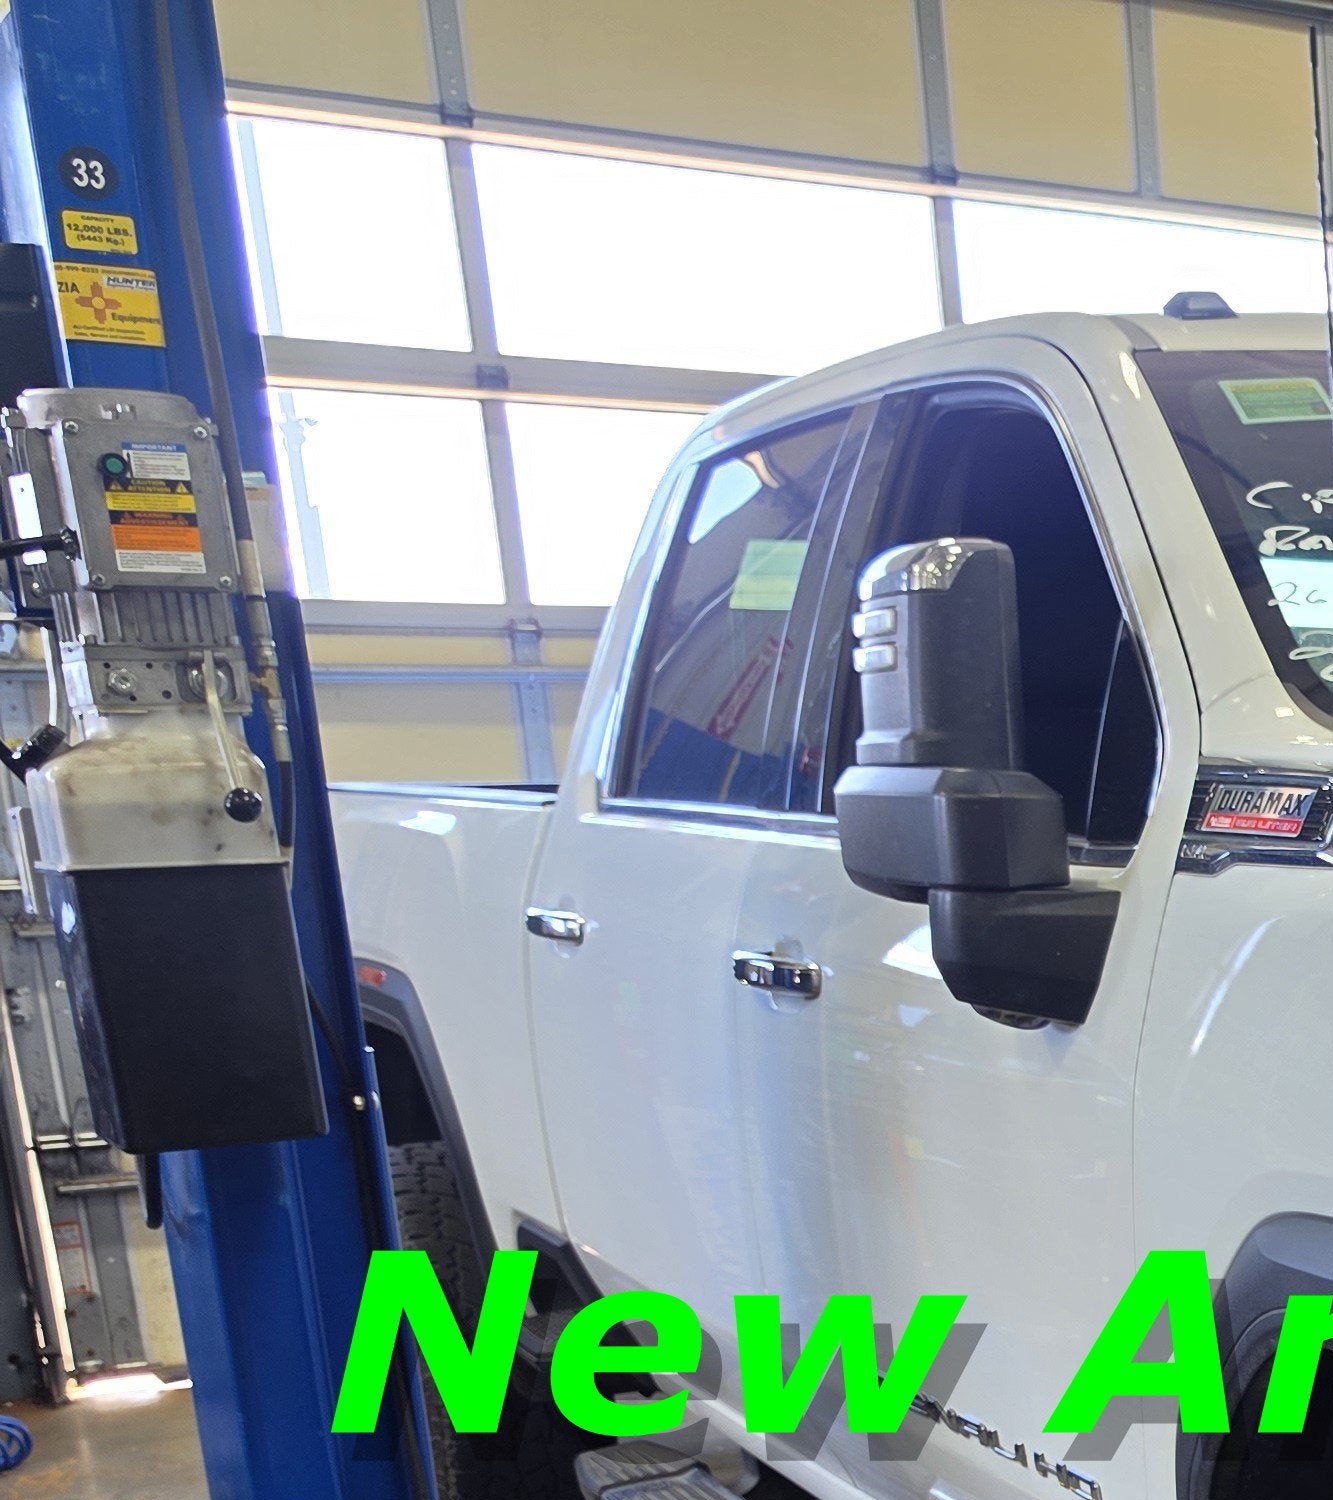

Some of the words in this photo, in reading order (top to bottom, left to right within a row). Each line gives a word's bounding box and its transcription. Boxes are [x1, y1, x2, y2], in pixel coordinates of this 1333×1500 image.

[71, 157, 106, 190] 33
[81, 215, 114, 223] CAPACITY
[66, 223, 104, 234] 12,000
[106, 227, 133, 237] LBS.
[57, 282, 80, 294] ZIA
[1218, 789, 1309, 816] DURAMAX
